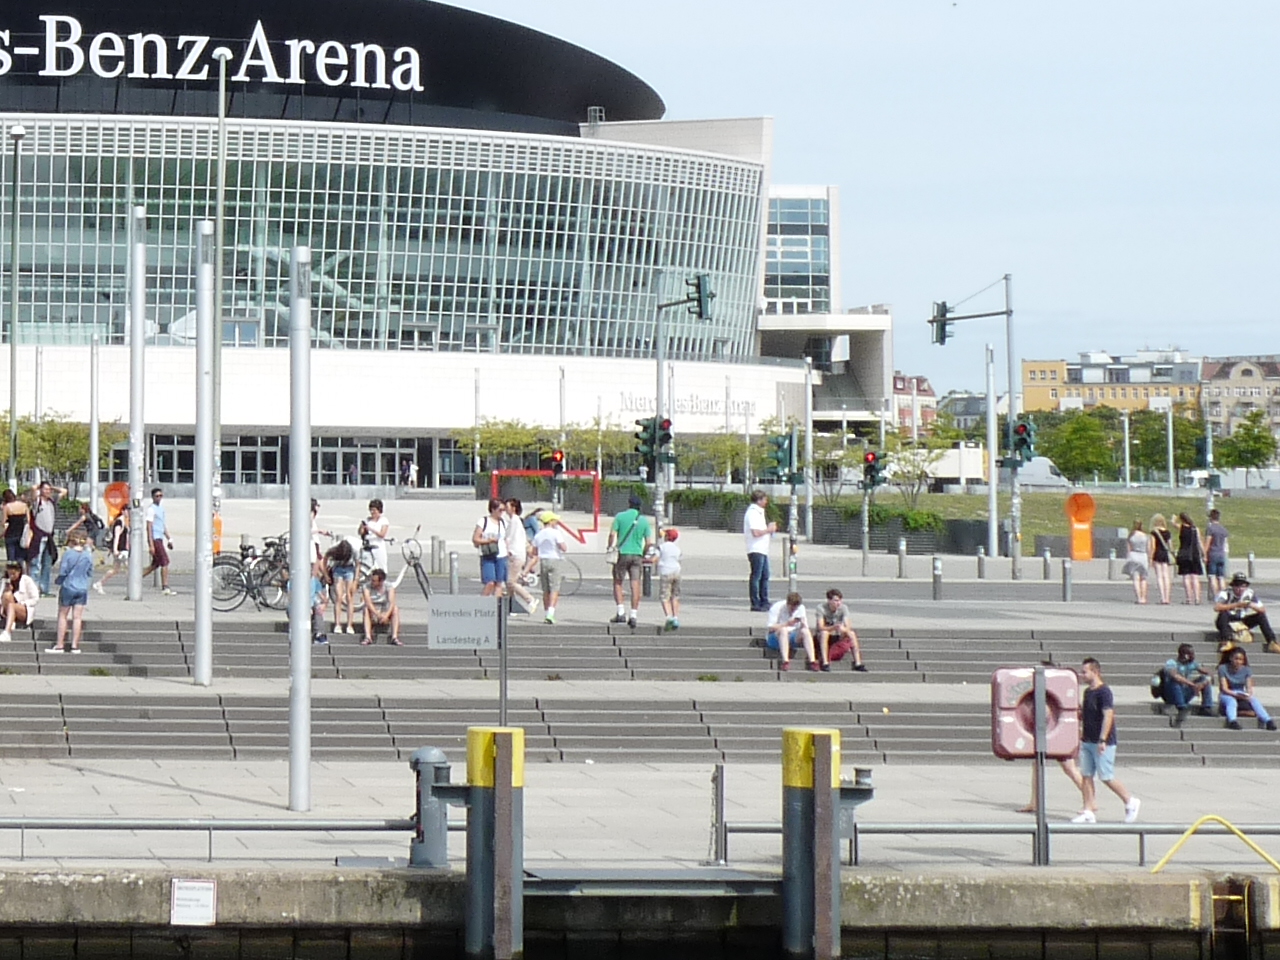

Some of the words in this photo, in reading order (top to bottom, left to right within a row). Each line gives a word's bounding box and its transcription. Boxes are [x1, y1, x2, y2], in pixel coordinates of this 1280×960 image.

[231, 19, 424, 92] Arena
[619, 391, 721, 415] Merces-Benz
[431, 608, 471, 618] Mercedes
[474, 608, 496, 618] Platz
[436, 635, 481, 646] Landesteg
[484, 636, 490, 644] A
